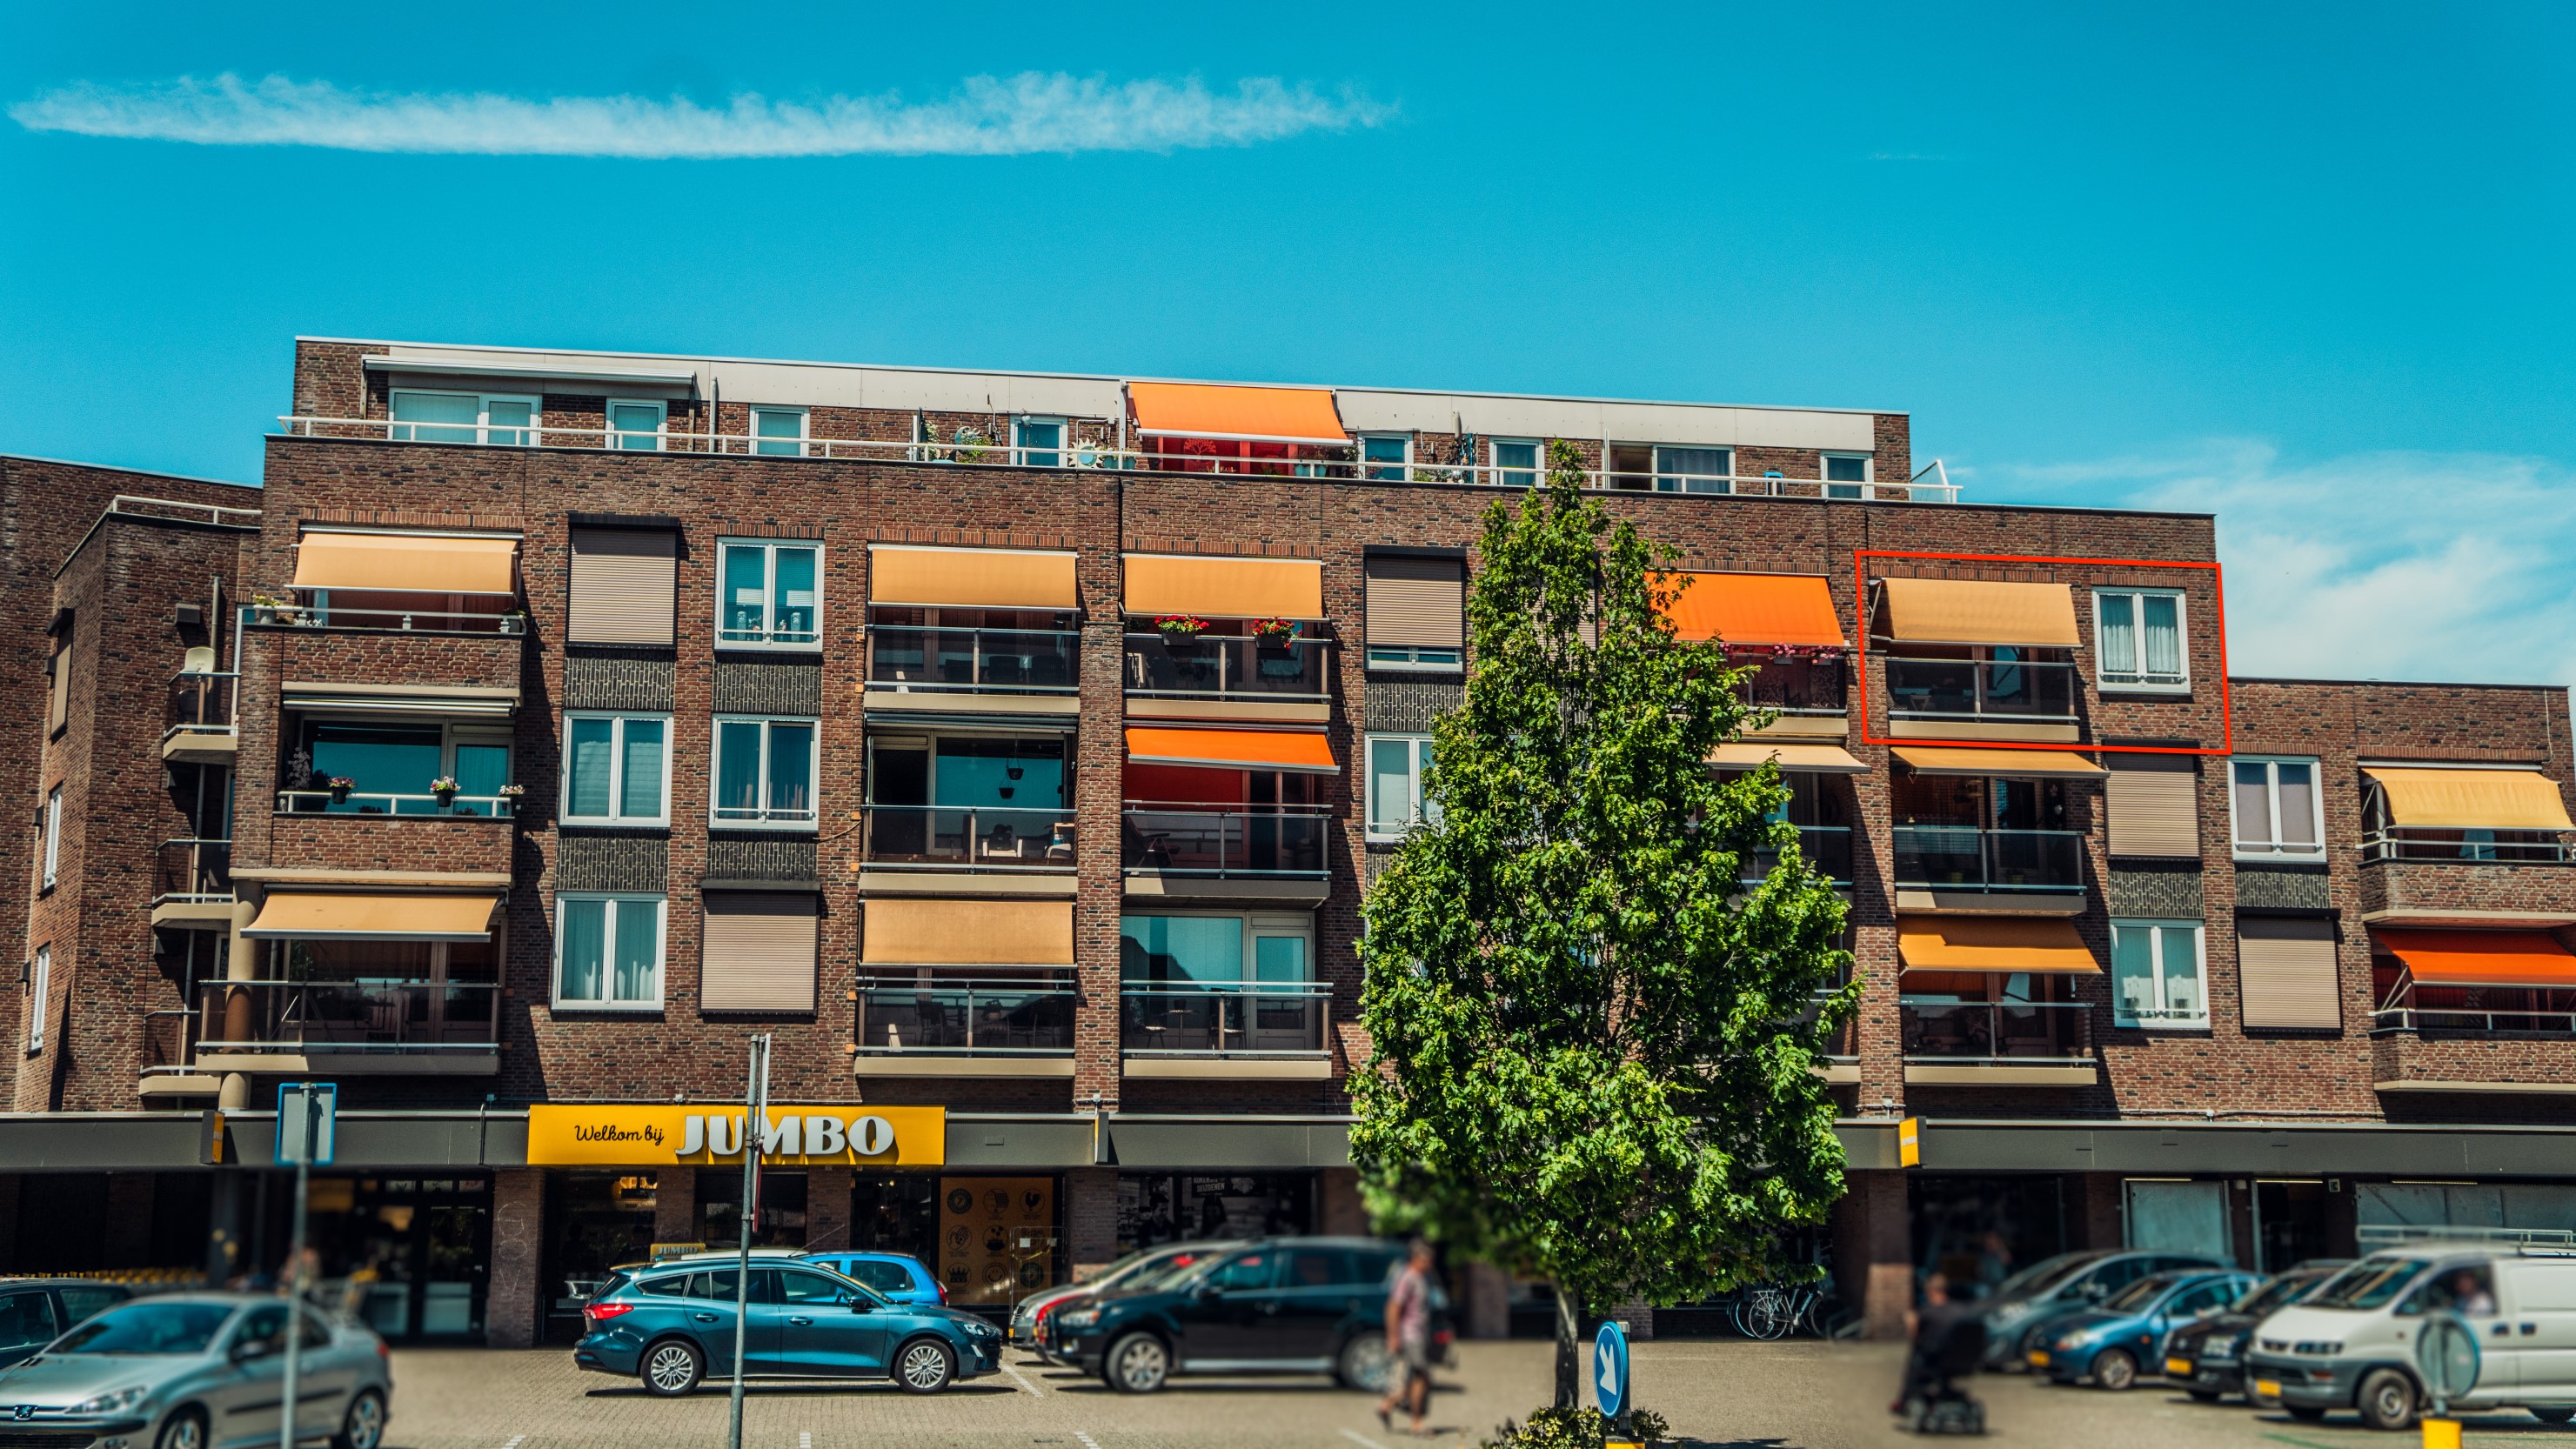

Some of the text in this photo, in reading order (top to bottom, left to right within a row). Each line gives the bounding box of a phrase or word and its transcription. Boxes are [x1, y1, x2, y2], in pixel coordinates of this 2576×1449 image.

[574, 1115, 895, 1156] Welkom bij JUMBO
[659, 1246, 699, 1256] JUMBO
